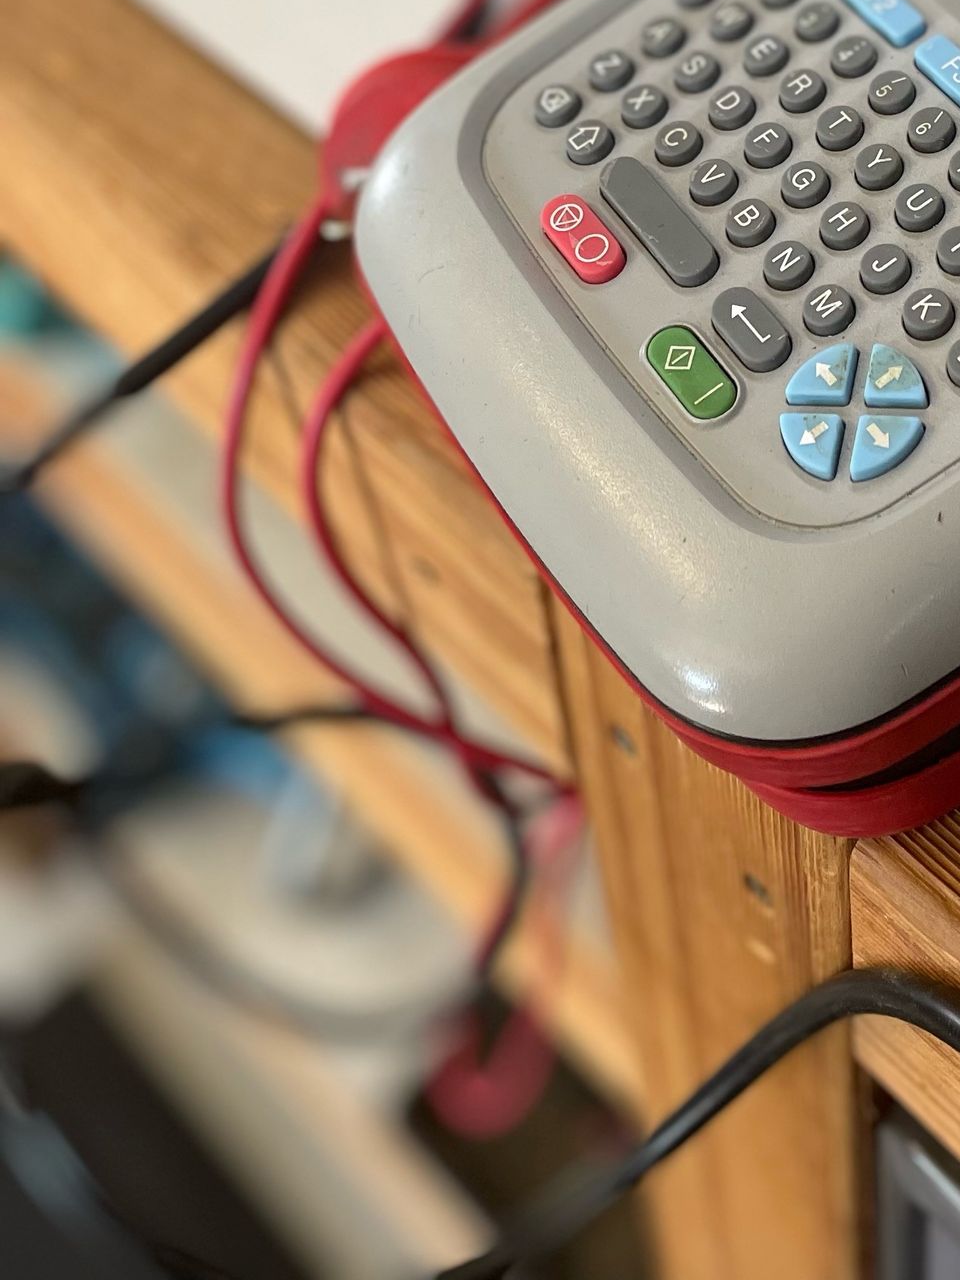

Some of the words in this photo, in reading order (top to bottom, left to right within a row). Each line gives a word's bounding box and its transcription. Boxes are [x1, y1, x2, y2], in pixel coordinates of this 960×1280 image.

[750, 38, 778, 60] E
[593, 53, 622, 76] Z
[681, 54, 707, 76] S
[787, 73, 813, 95] R
[875, 84, 893, 97] 5
[627, 88, 655, 110] X
[715, 91, 741, 110] D
[828, 110, 853, 129] T
[915, 122, 932, 135] 6
[664, 127, 688, 147] C
[752, 128, 779, 143] F
[867, 148, 892, 168] Y
[700, 164, 726, 184] V
[791, 168, 816, 191] G
[906, 188, 934, 211] U
[733, 204, 760, 227] B
[828, 207, 857, 232] H
[771, 246, 801, 272] N
[871, 257, 898, 272] J
[809, 289, 843, 319] M
[911, 293, 942, 320] K
